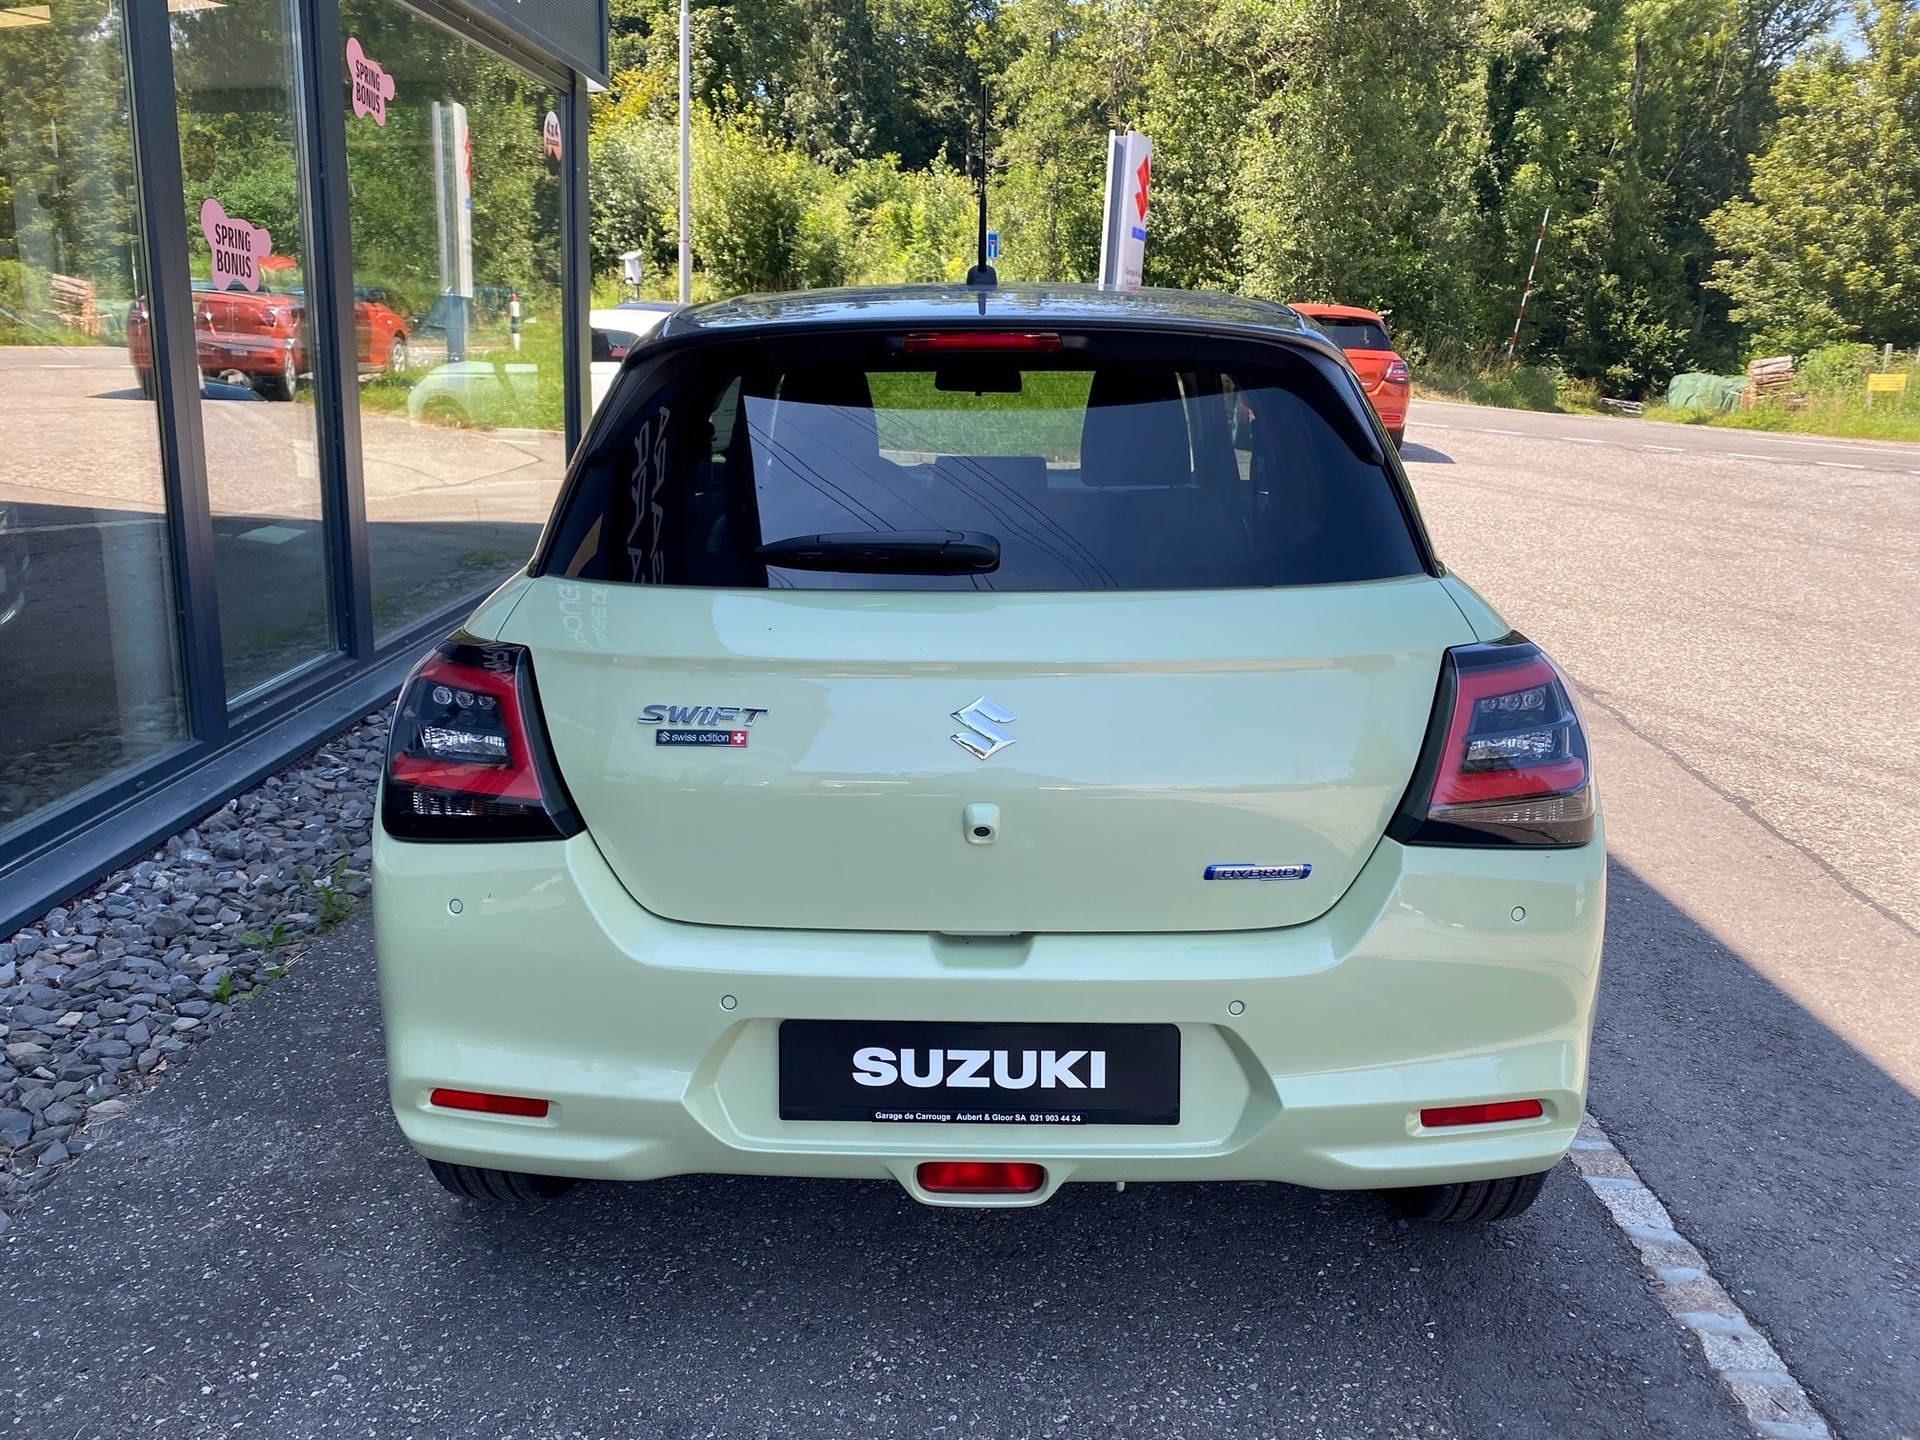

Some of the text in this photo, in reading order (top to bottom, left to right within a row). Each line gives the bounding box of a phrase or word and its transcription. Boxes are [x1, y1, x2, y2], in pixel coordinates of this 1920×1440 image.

[355, 59, 380, 92] SPRING
[356, 81, 380, 114] BONUS
[214, 223, 252, 252] SPRING
[216, 248, 252, 278] BONUS
[637, 704, 770, 727] SWIFT
[671, 731, 729, 742] swiss edition
[1220, 867, 1299, 880] HYBRID
[852, 1047, 1106, 1089] SUZUKI
[875, 1112, 903, 1121] Garage
[904, 1112, 914, 1120] de
[915, 1112, 951, 1122] Carrouge
[956, 1113, 983, 1121] Aubert
[991, 1113, 1014, 1121] Gloor
[1029, 1114, 1043, 1122] 021
